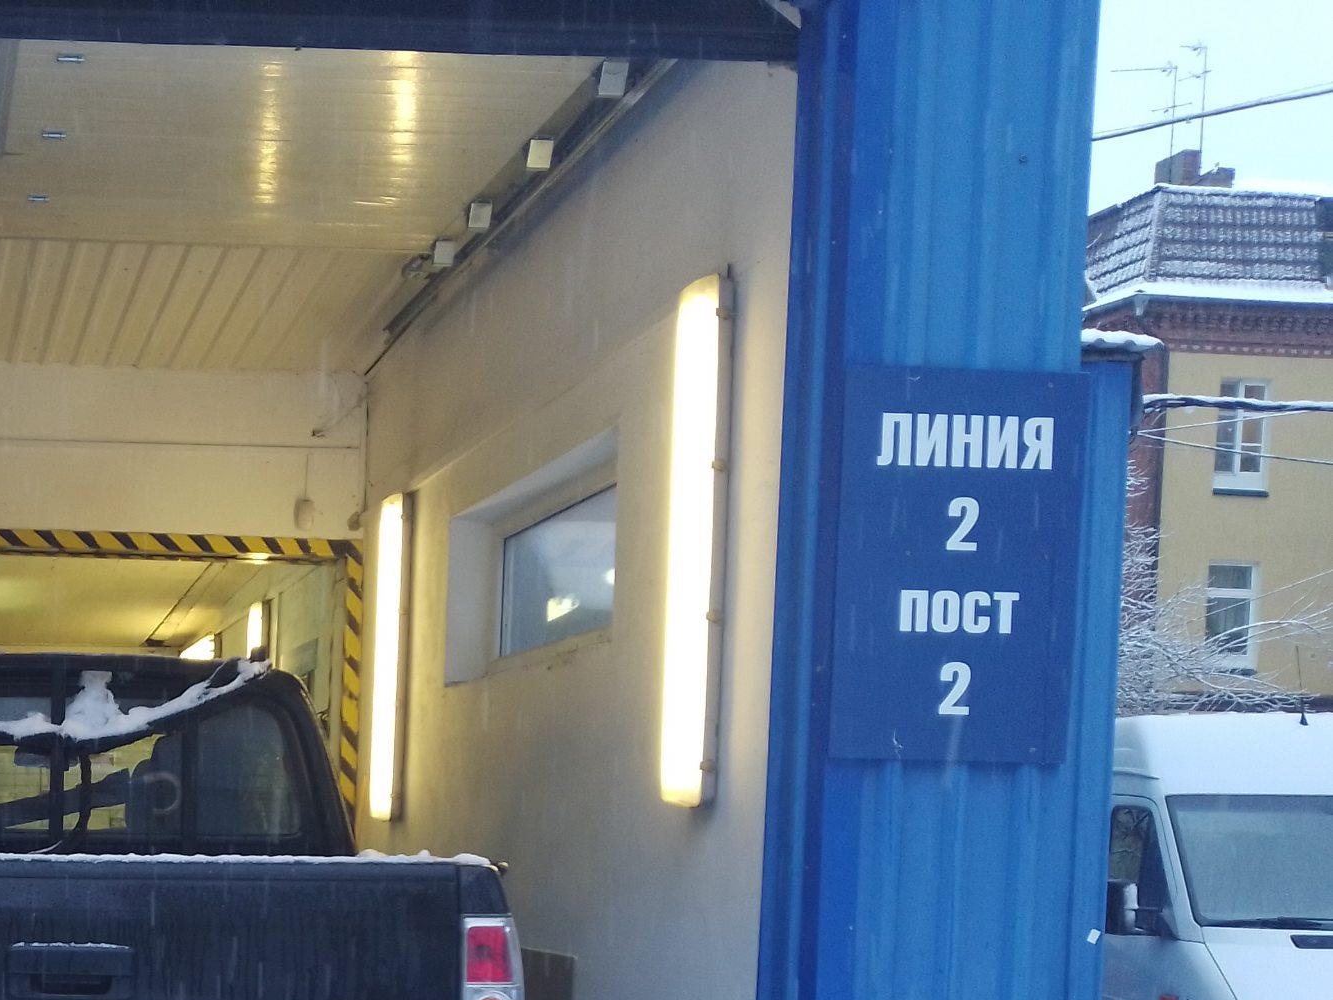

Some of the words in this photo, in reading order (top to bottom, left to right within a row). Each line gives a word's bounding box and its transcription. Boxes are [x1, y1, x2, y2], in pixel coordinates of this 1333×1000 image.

[876, 412, 1055, 470] ЛИНИЯ
[945, 496, 980, 552] 2
[899, 589, 1020, 634] ПОСТ
[938, 661, 972, 716] 2
